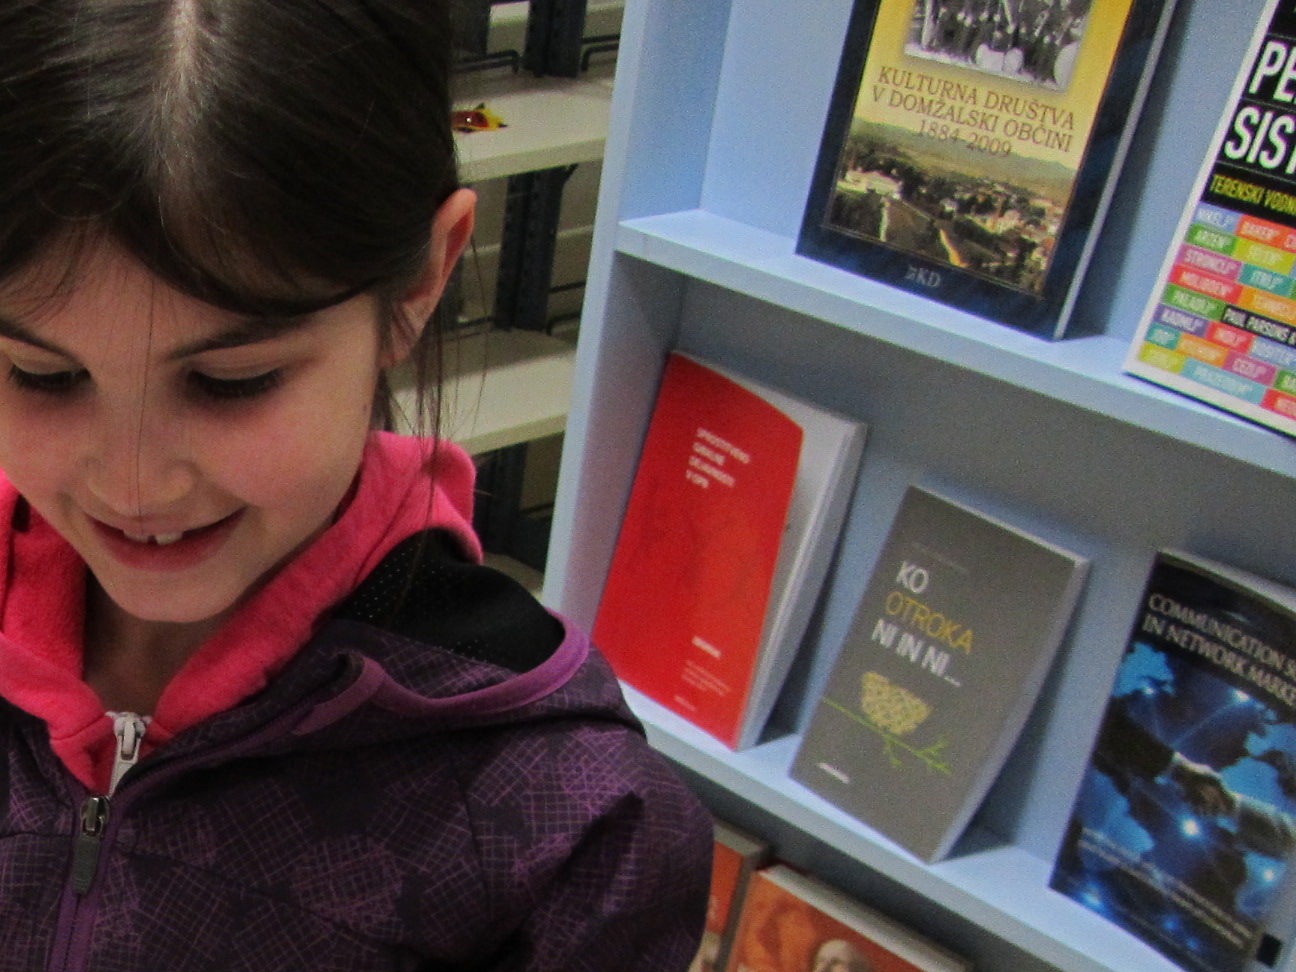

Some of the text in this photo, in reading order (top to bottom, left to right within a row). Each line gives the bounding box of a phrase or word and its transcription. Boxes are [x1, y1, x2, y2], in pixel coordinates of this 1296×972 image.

[872, 85, 1073, 152] V DOMŽALSKI OBČINI
[877, 66, 1074, 130] KULTURNA DRUŠTVA
[1210, 174, 1265, 205] TERENSKI
[896, 561, 929, 594] KO
[871, 618, 898, 648] NI
[896, 631, 925, 663] IN
[885, 591, 974, 655] OTROKA
[1142, 612, 1167, 635] IN
[1165, 624, 1247, 676] NETWORK
[1149, 594, 1286, 671] COMMUNICATION
